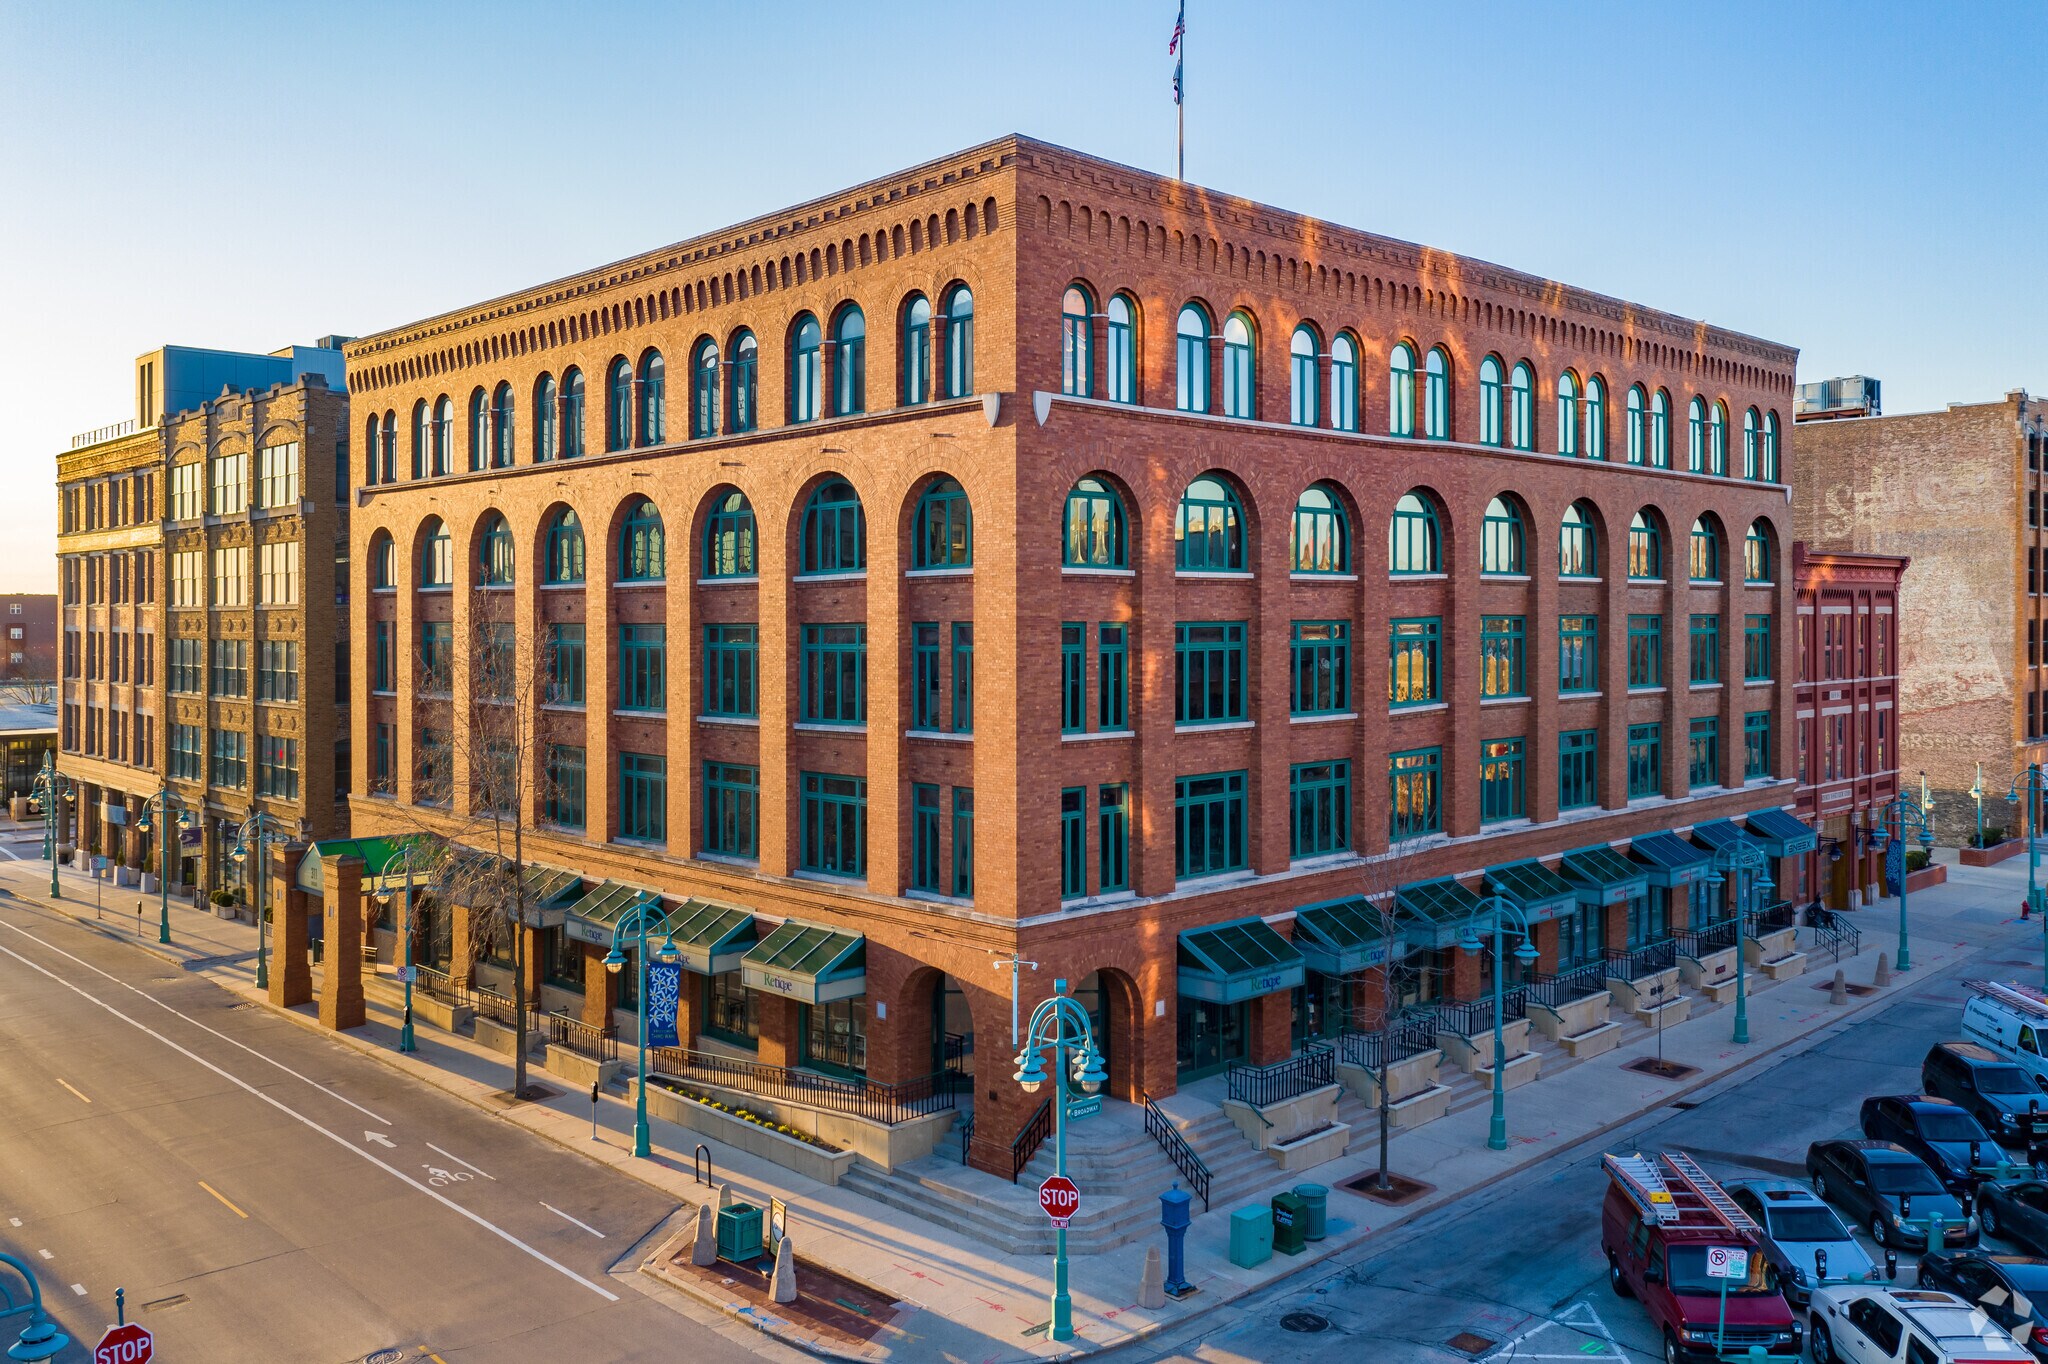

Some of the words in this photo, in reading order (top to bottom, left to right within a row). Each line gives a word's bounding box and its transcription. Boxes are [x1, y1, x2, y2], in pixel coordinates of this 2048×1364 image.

[183, 847, 202, 856] EYE
[1073, 1104, 1099, 1117] BROADWAY
[1042, 1188, 1078, 1207] STOP
[97, 1337, 150, 1364] STOP
